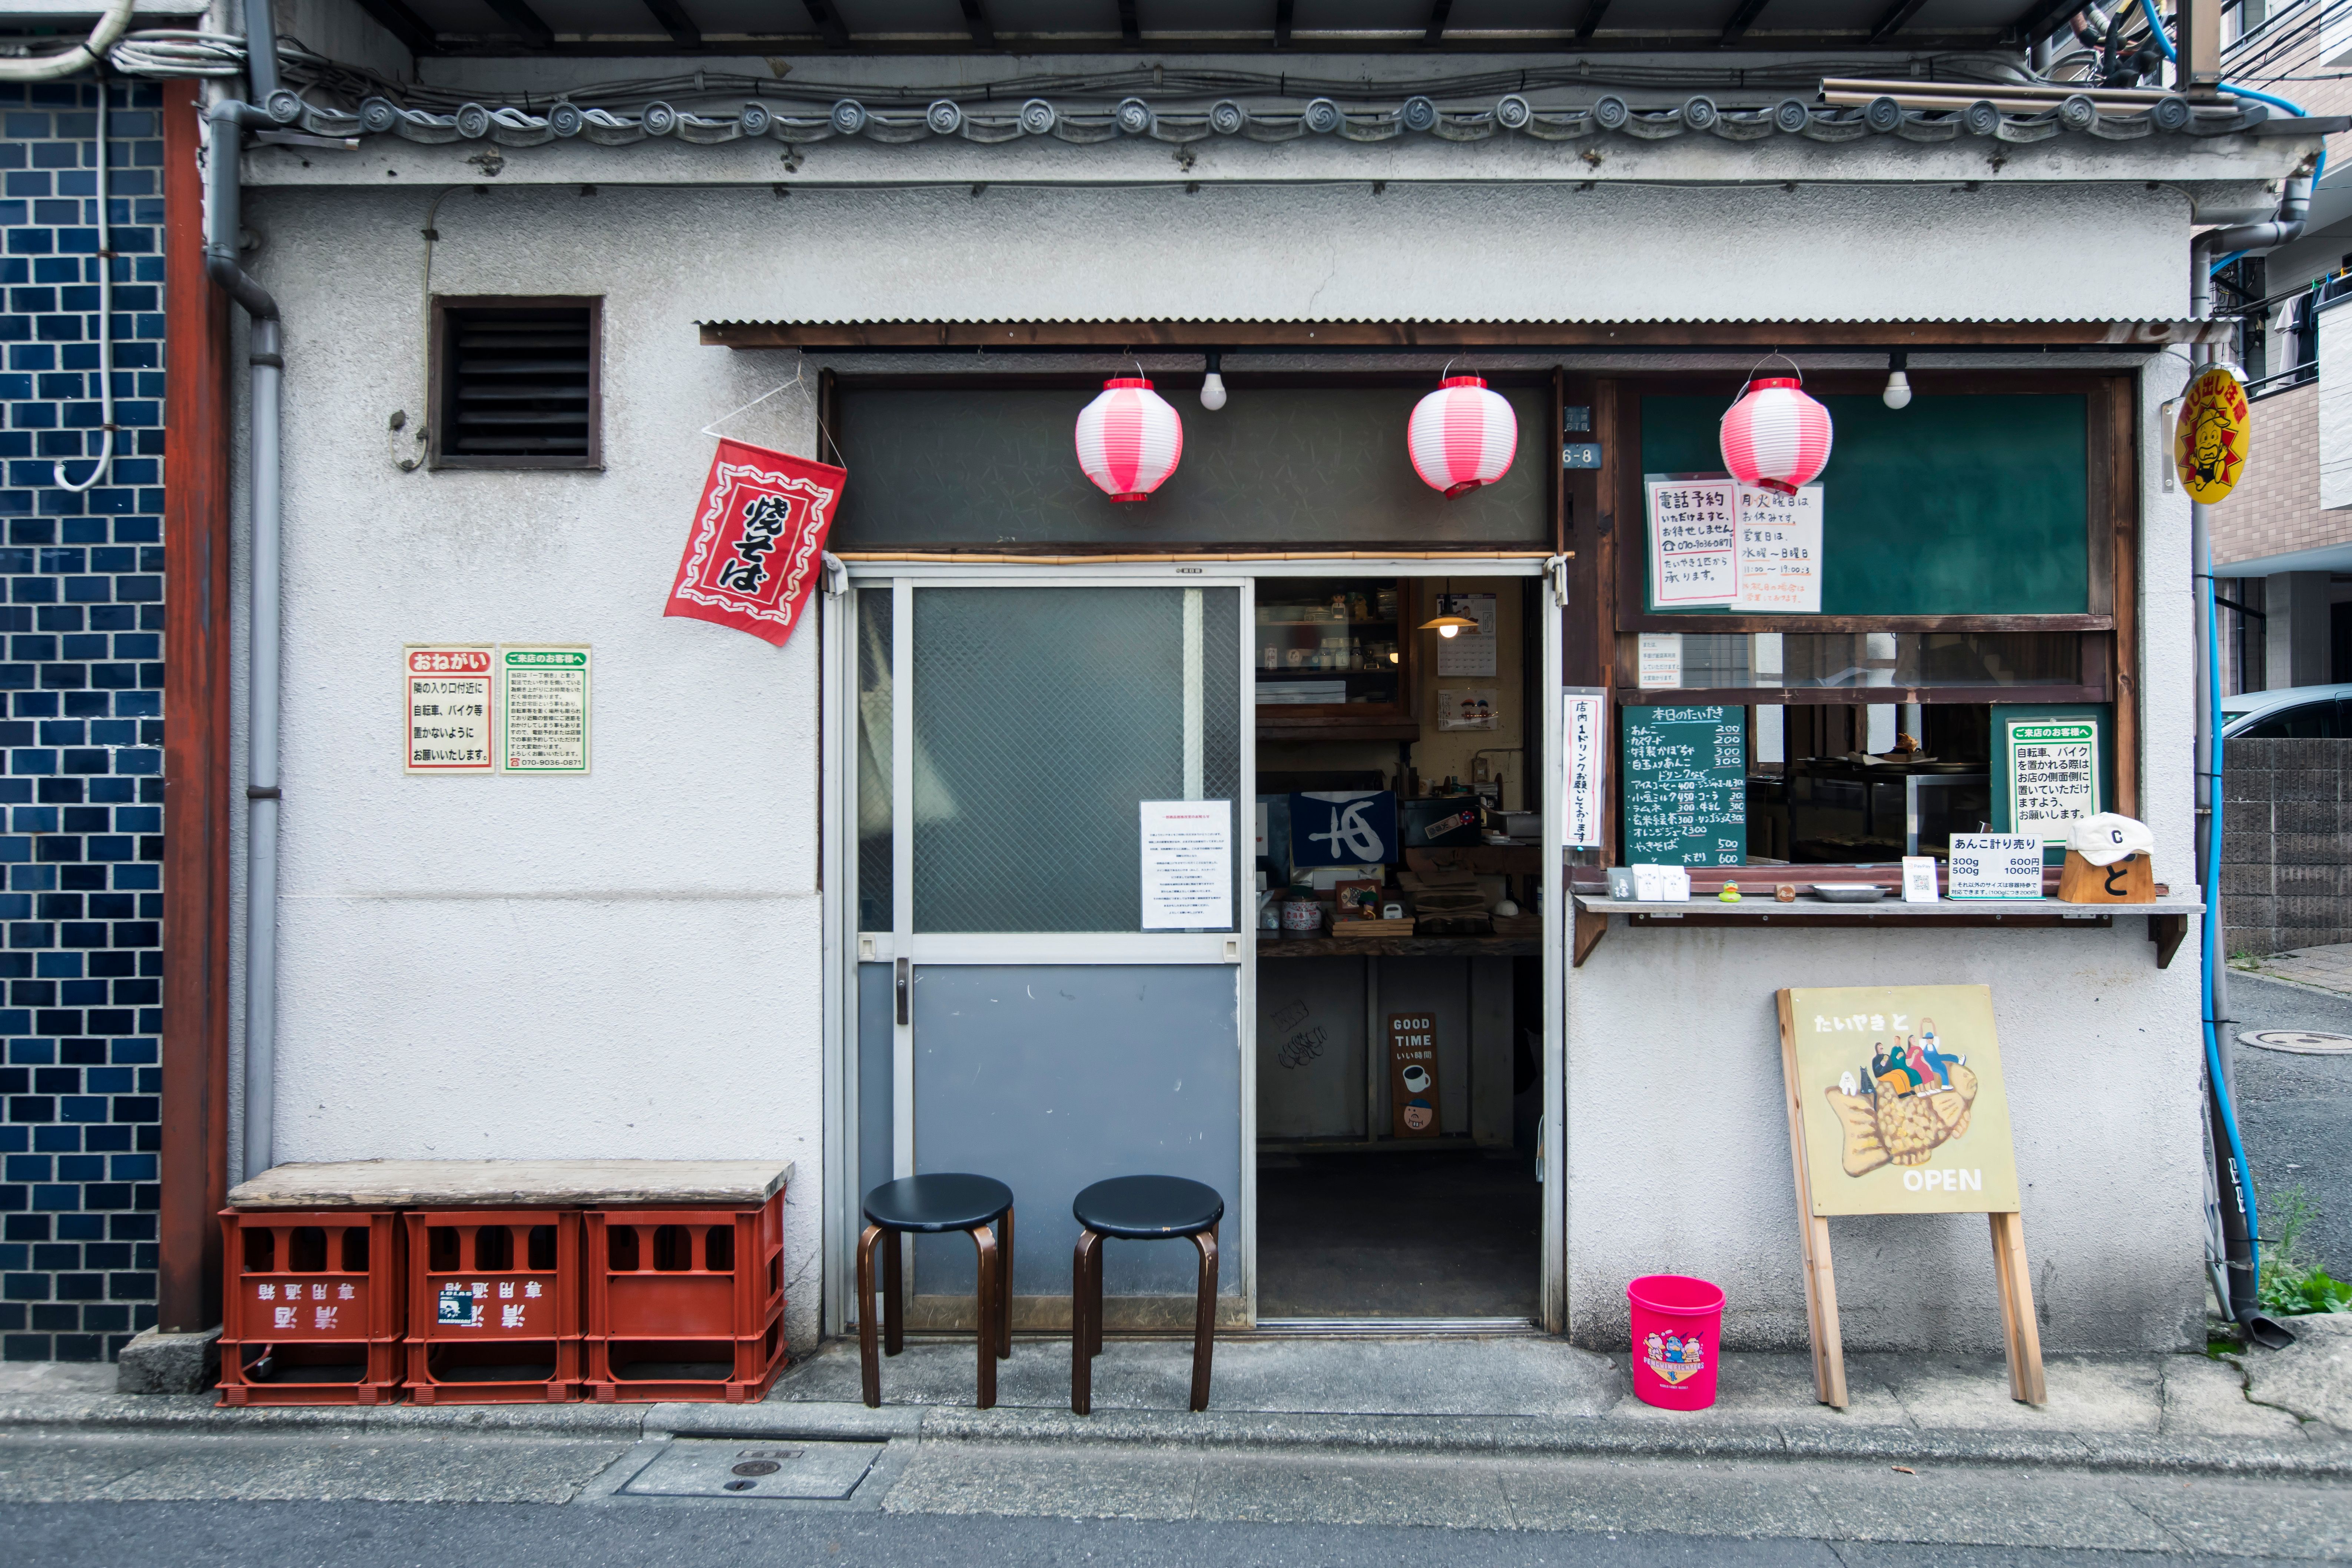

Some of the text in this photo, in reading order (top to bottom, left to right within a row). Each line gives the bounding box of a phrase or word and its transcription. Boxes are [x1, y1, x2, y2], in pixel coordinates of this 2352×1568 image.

[1563, 450, 1591, 463] 6-8
[1659, 491, 1724, 508] 電話予約
[1743, 511, 1795, 524] お休みです。
[1744, 528, 1788, 542] 営業日は、
[717, 495, 790, 594] 焼そば
[1678, 538, 1732, 550] 070-9036-0871
[1665, 557, 1727, 567] たいやき1匹から
[1665, 570, 1715, 583] 承ります。
[414, 653, 487, 670] おねがい
[507, 653, 584, 663] ご来店のお客様へ
[414, 682, 482, 694] 隣の入り口付近に
[414, 705, 482, 717] 自転車、バイク等
[1652, 706, 1724, 721] 本日のたいやき
[414, 727, 474, 739] 置かないように
[1631, 725, 1658, 736] あんこ
[2016, 728, 2089, 737] ご来店のお客様へ
[1631, 736, 1666, 746] カスタード
[414, 749, 487, 761] お願いいたします。
[1631, 745, 1740, 758] 特製かぼちゃ 300
[2017, 747, 2087, 758] 自転車、バイク
[1633, 757, 1691, 770] 白玉入りあんこ
[2018, 760, 2089, 770] を置かれる際は
[1659, 769, 1709, 780] ドリンクなど
[2018, 772, 2089, 782] お店の側面側に
[1631, 780, 1676, 790] アイスコーヒー
[2018, 784, 2089, 795] 置いていただけ
[1632, 791, 1676, 802] 小豆ミルク
[1678, 793, 1694, 801] 450
[1698, 791, 1718, 800] コーラ
[2019, 797, 2063, 808] ますよう、
[1633, 803, 1662, 813] ラムネ
[1633, 813, 1677, 827] 玄米緑茶
[2019, 809, 2084, 820] お願いします。
[2112, 830, 2123, 843] C
[1634, 838, 1738, 852] やきそば 500
[1955, 839, 2035, 849] あんこ計り売り
[1682, 852, 1706, 862] 大もり
[1719, 853, 1738, 863] 600
[1953, 858, 1978, 866] 300g
[1953, 867, 1979, 876] 500g
[2104, 865, 2127, 896] と
[1394, 1018, 1429, 1030] GOOD
[1815, 1014, 1909, 1032] たいやきと
[1395, 1035, 1431, 1047] TIME
[1397, 1051, 1432, 1059] いい時間
[1903, 1168, 1981, 1191] OPEN
[258, 1283, 355, 1300] 専用通箱
[274, 1306, 338, 1329] 清酒
[1643, 1356, 1704, 1370] PENGUIN FIGHTERS
